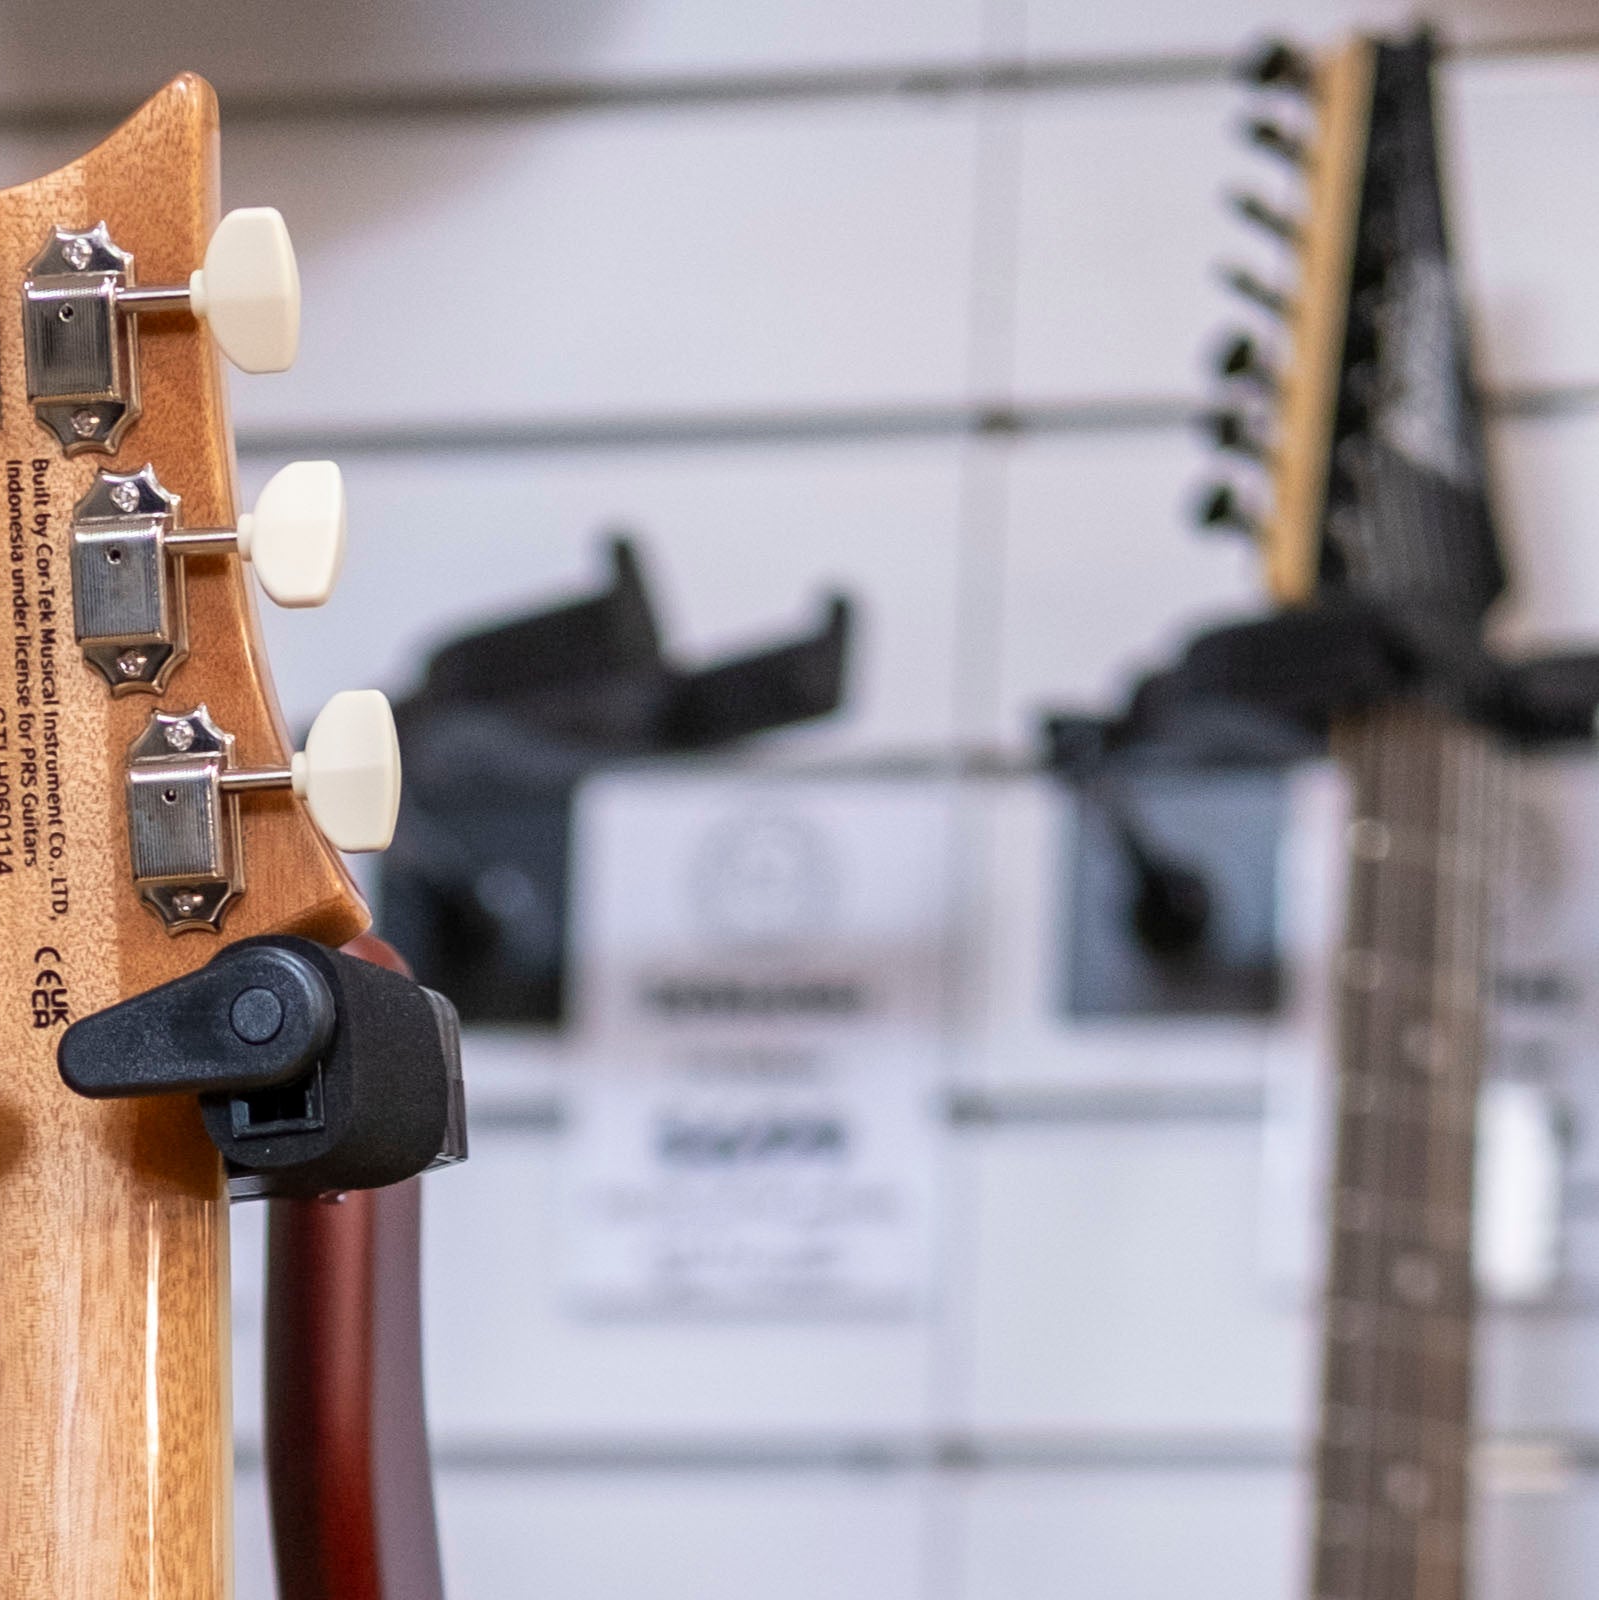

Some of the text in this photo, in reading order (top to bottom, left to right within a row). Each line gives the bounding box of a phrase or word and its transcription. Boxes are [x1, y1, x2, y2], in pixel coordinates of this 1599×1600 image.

[32, 459, 51, 508] Built
[30, 513, 52, 538] by
[36, 543, 56, 622] Cor-Tek
[6, 460, 39, 867] Indonesia under license for PRS Guitars
[40, 628, 60, 705] Musical
[43, 711, 64, 826] Instrument
